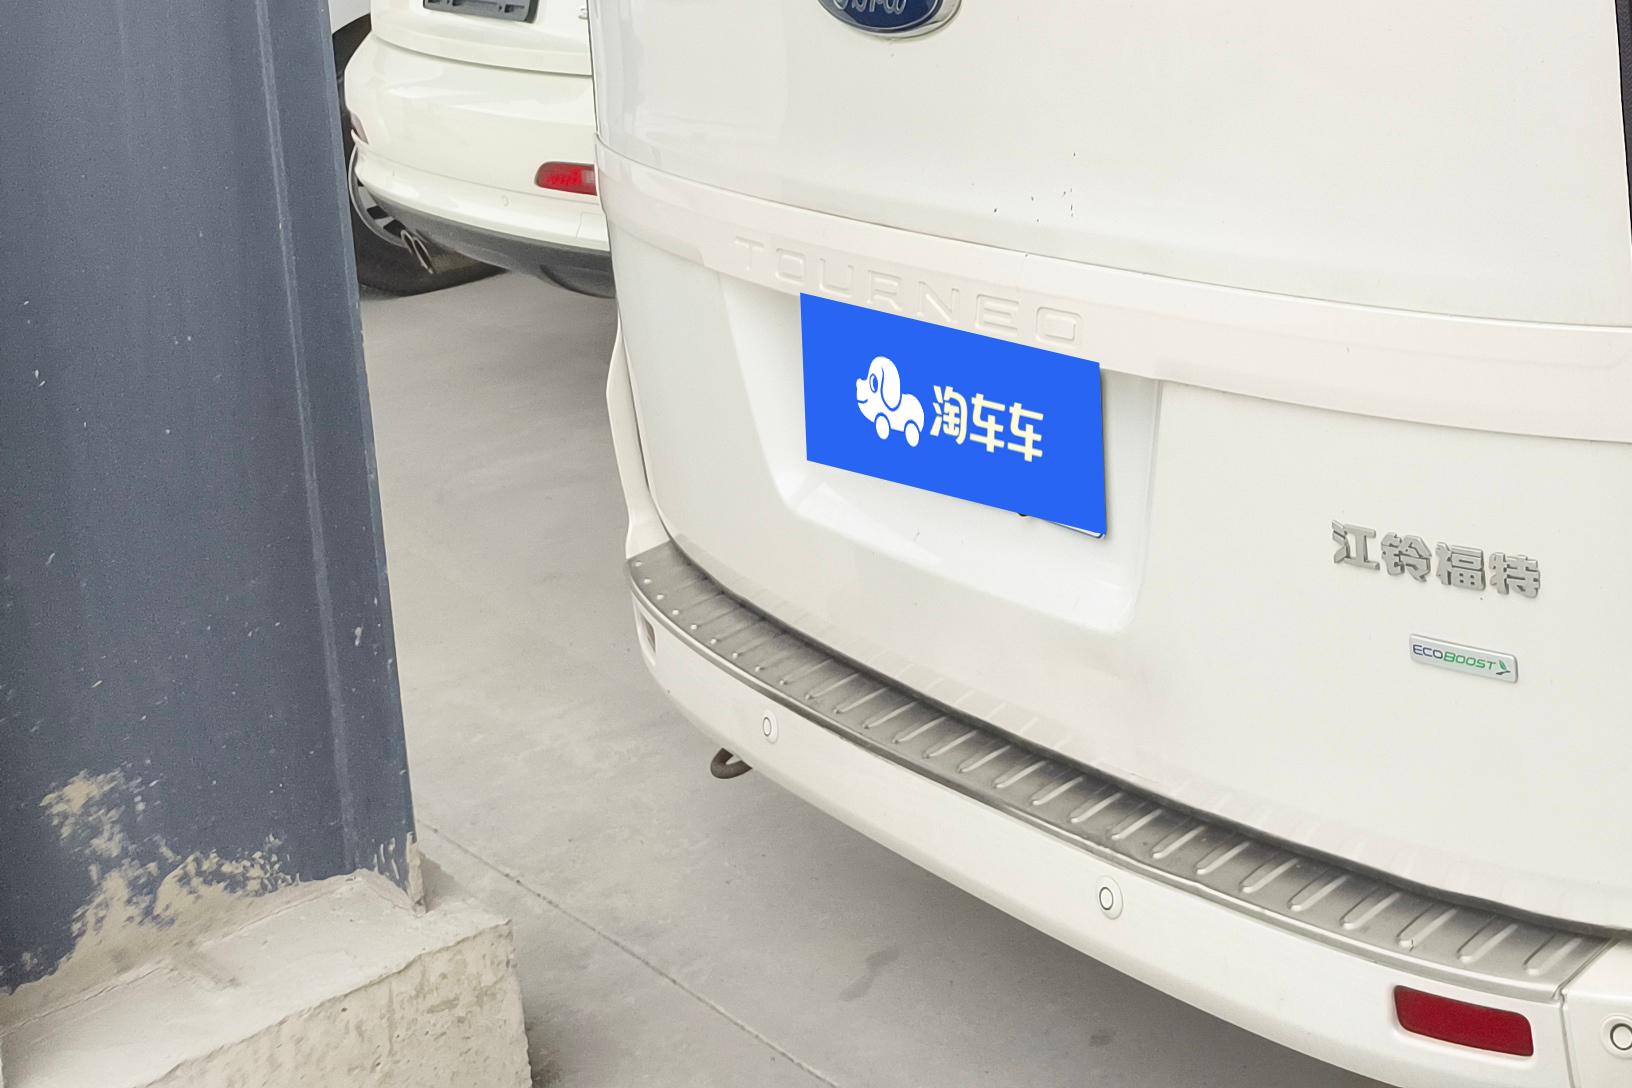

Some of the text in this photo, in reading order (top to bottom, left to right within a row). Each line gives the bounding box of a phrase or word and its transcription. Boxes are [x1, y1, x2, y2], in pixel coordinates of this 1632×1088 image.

[733, 234, 1084, 347] TOURNEO
[1331, 519, 1541, 599] 江铃福特
[1412, 643, 1497, 671] ECOBOOST
